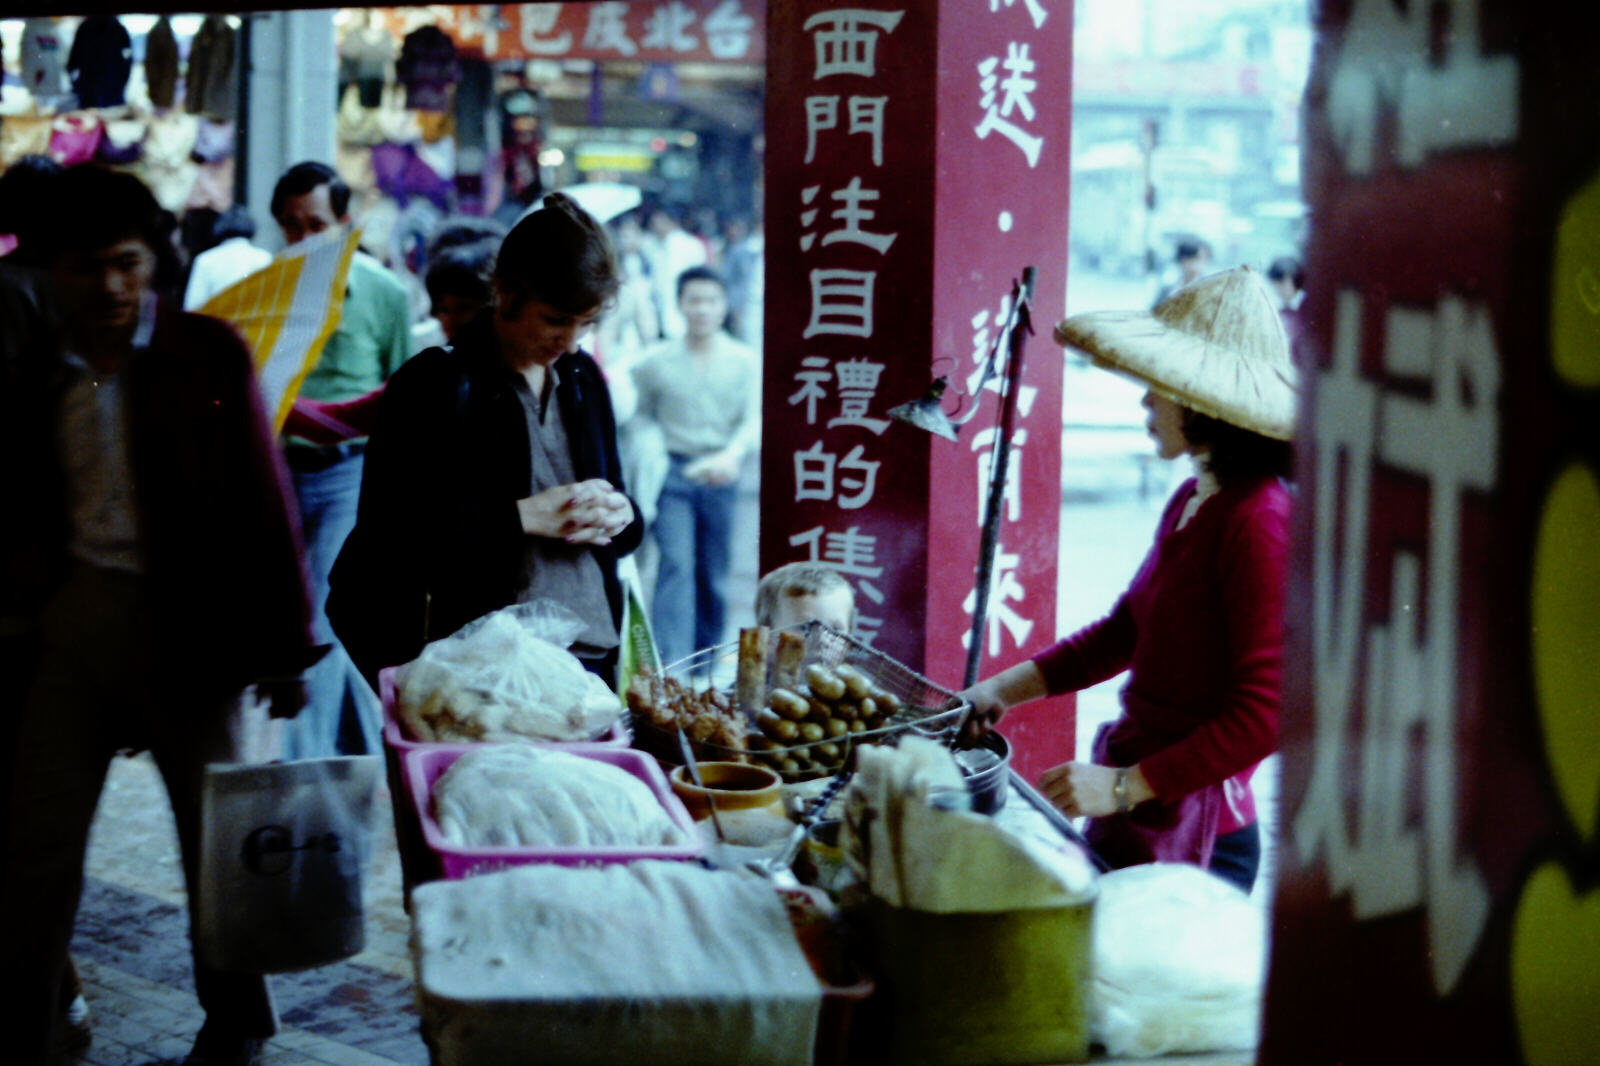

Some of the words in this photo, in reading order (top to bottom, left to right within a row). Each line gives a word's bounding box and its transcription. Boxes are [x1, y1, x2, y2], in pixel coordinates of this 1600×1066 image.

[788, 8, 905, 648] 西門注目禮的集
